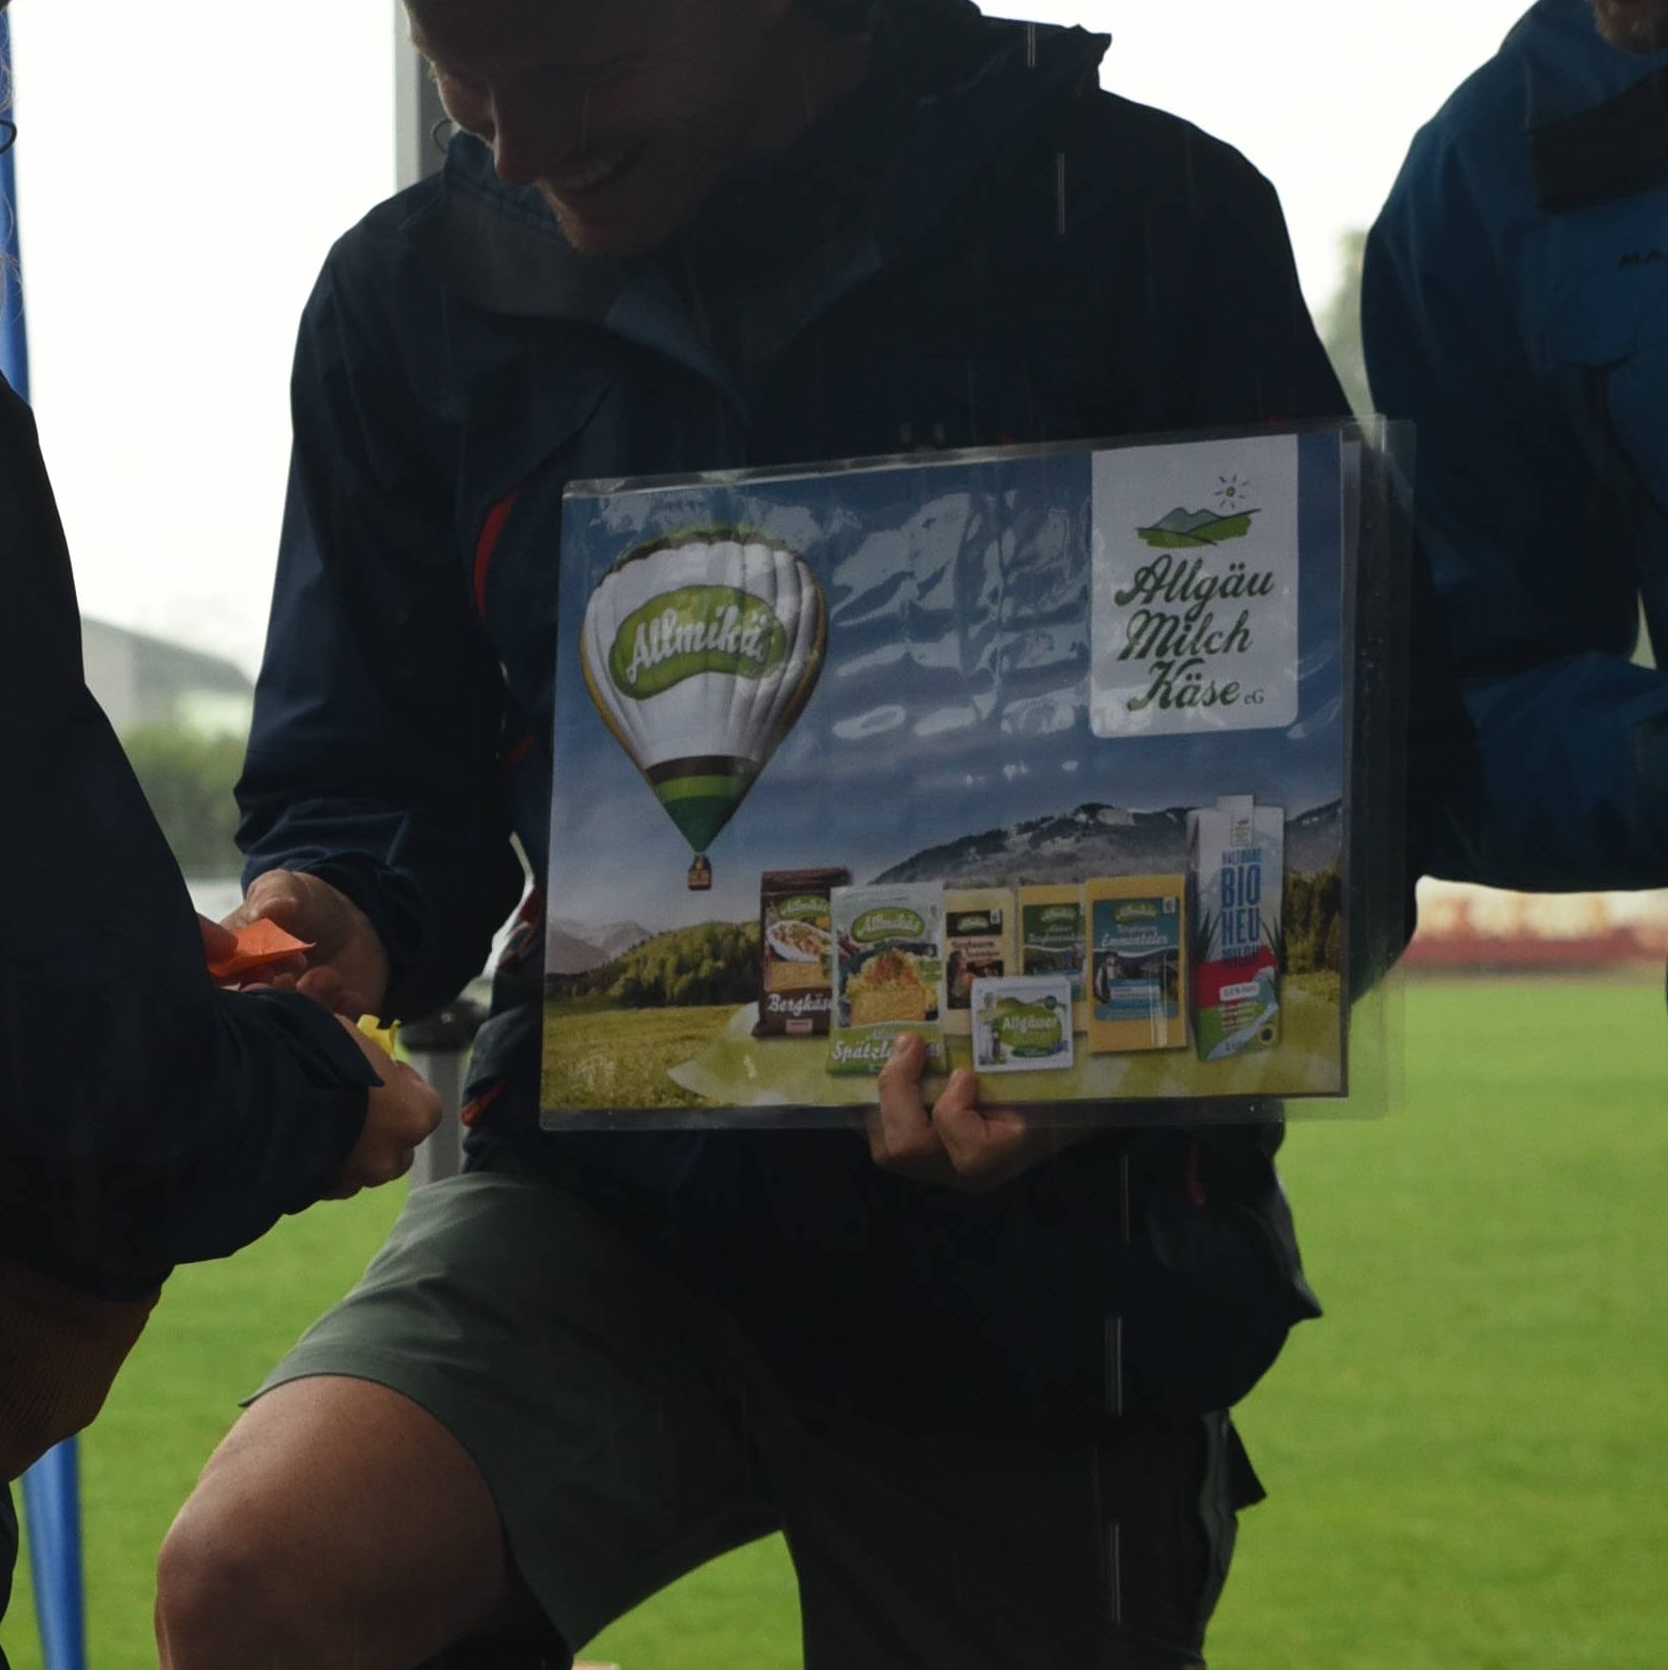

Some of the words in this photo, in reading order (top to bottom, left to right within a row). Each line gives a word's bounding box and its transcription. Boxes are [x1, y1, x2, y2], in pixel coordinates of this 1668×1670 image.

[1114, 553, 1275, 622] Allgäu
[626, 605, 770, 685] Allmikä
[1117, 608, 1252, 661] Milch
[1127, 657, 1241, 712] Käse
[1244, 689, 1265, 705] eG
[1221, 865, 1261, 908] BIO
[1221, 907, 1261, 945] HEU
